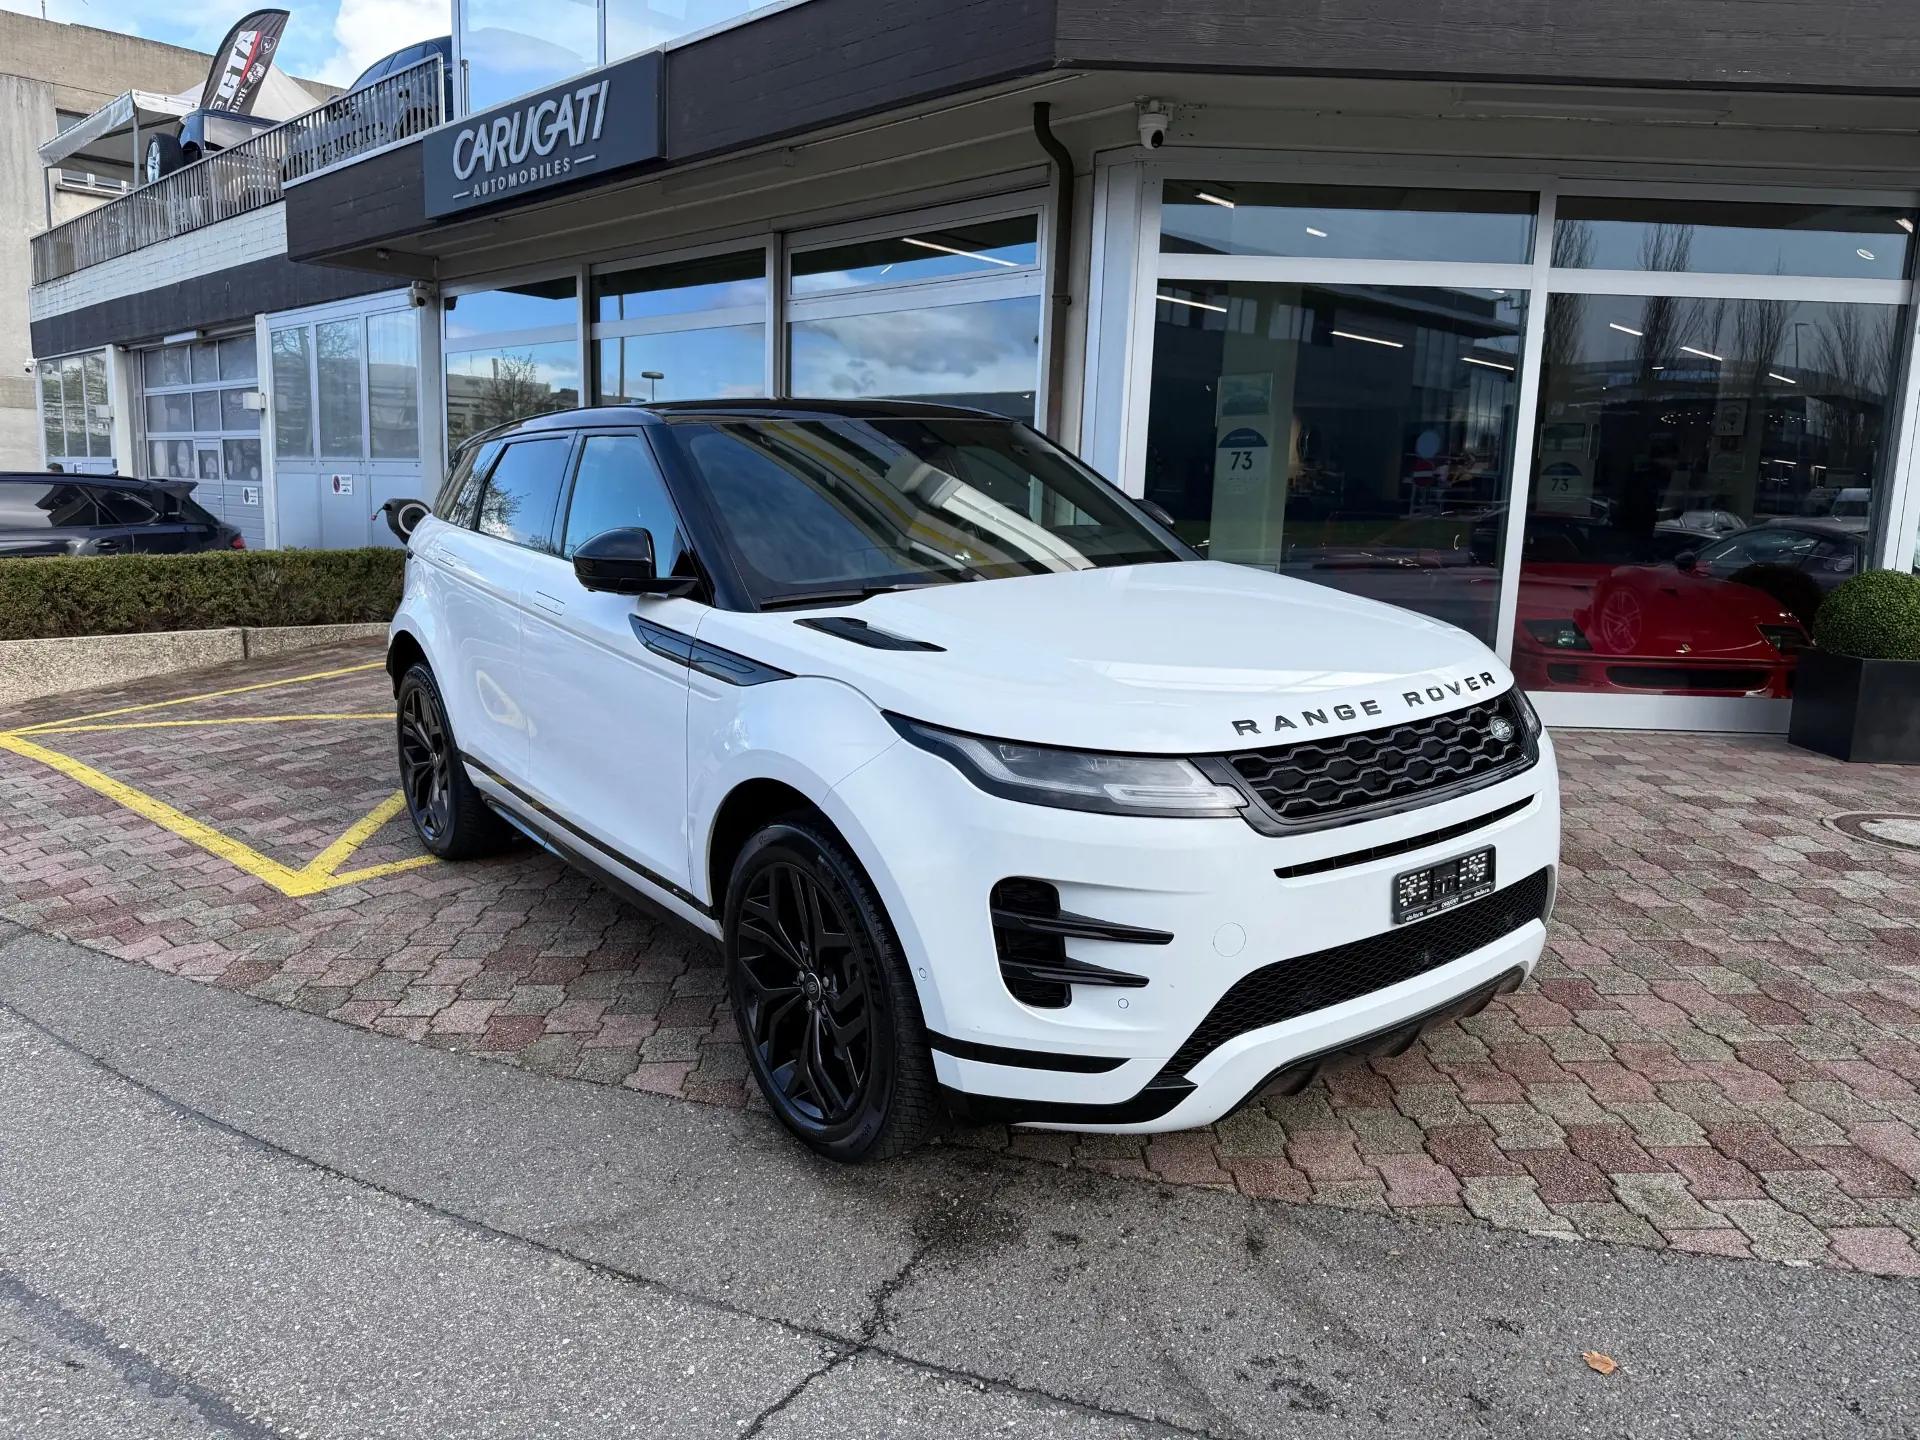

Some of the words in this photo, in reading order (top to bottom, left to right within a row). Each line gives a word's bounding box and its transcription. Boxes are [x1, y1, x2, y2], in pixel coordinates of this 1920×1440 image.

[452, 79, 610, 181] CARUGATI
[472, 156, 572, 198] AUTOMOBILES
[1230, 450, 1253, 471] 73
[1550, 478, 1569, 492] 73
[1231, 699, 1383, 736] RANGE
[1402, 671, 1496, 707] ROVER
